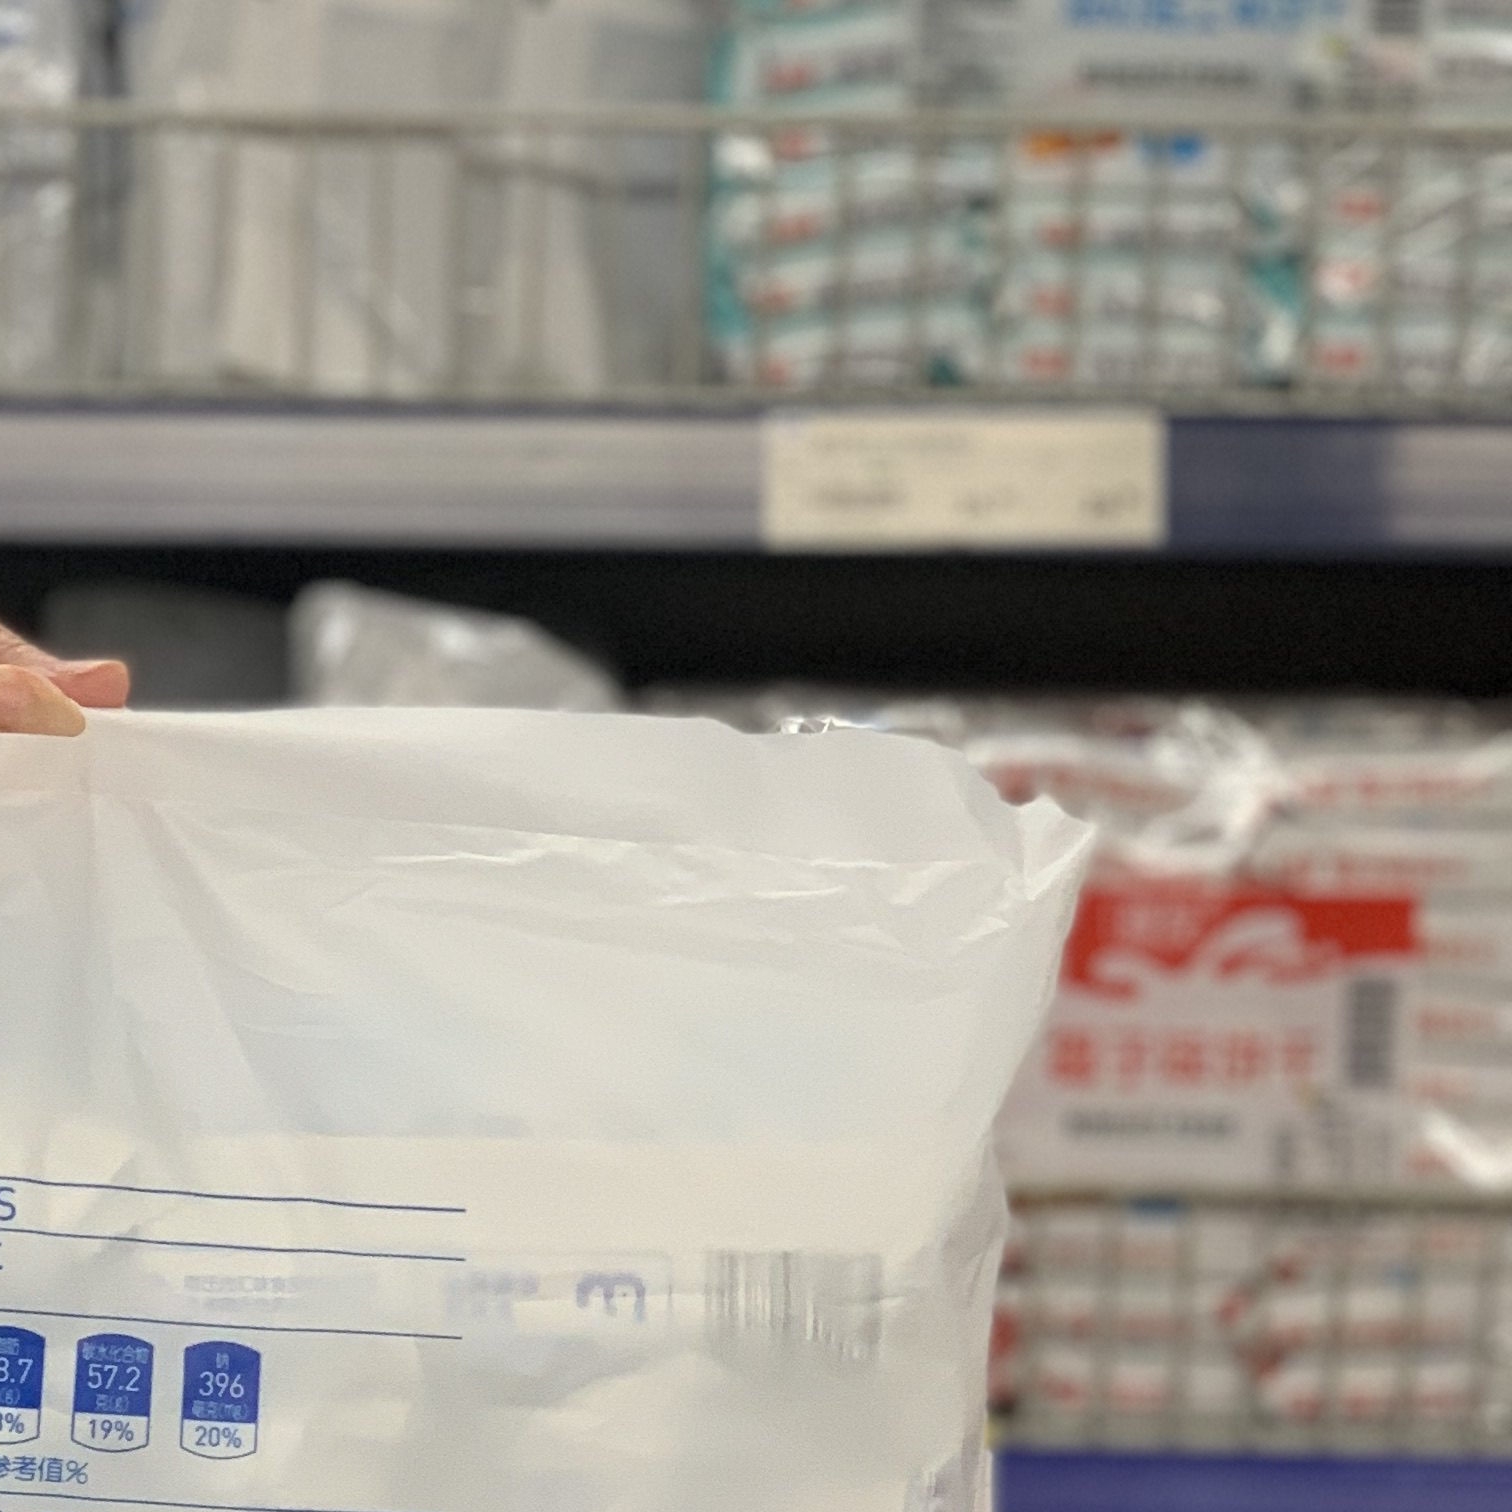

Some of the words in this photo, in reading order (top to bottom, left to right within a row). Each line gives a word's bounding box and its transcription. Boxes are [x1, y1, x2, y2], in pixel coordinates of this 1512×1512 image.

[87, 1364, 142, 1392] 57.2
[199, 1371, 245, 1398] 396
[88, 1417, 135, 1443] 19%
[194, 1425, 243, 1450] 20%
